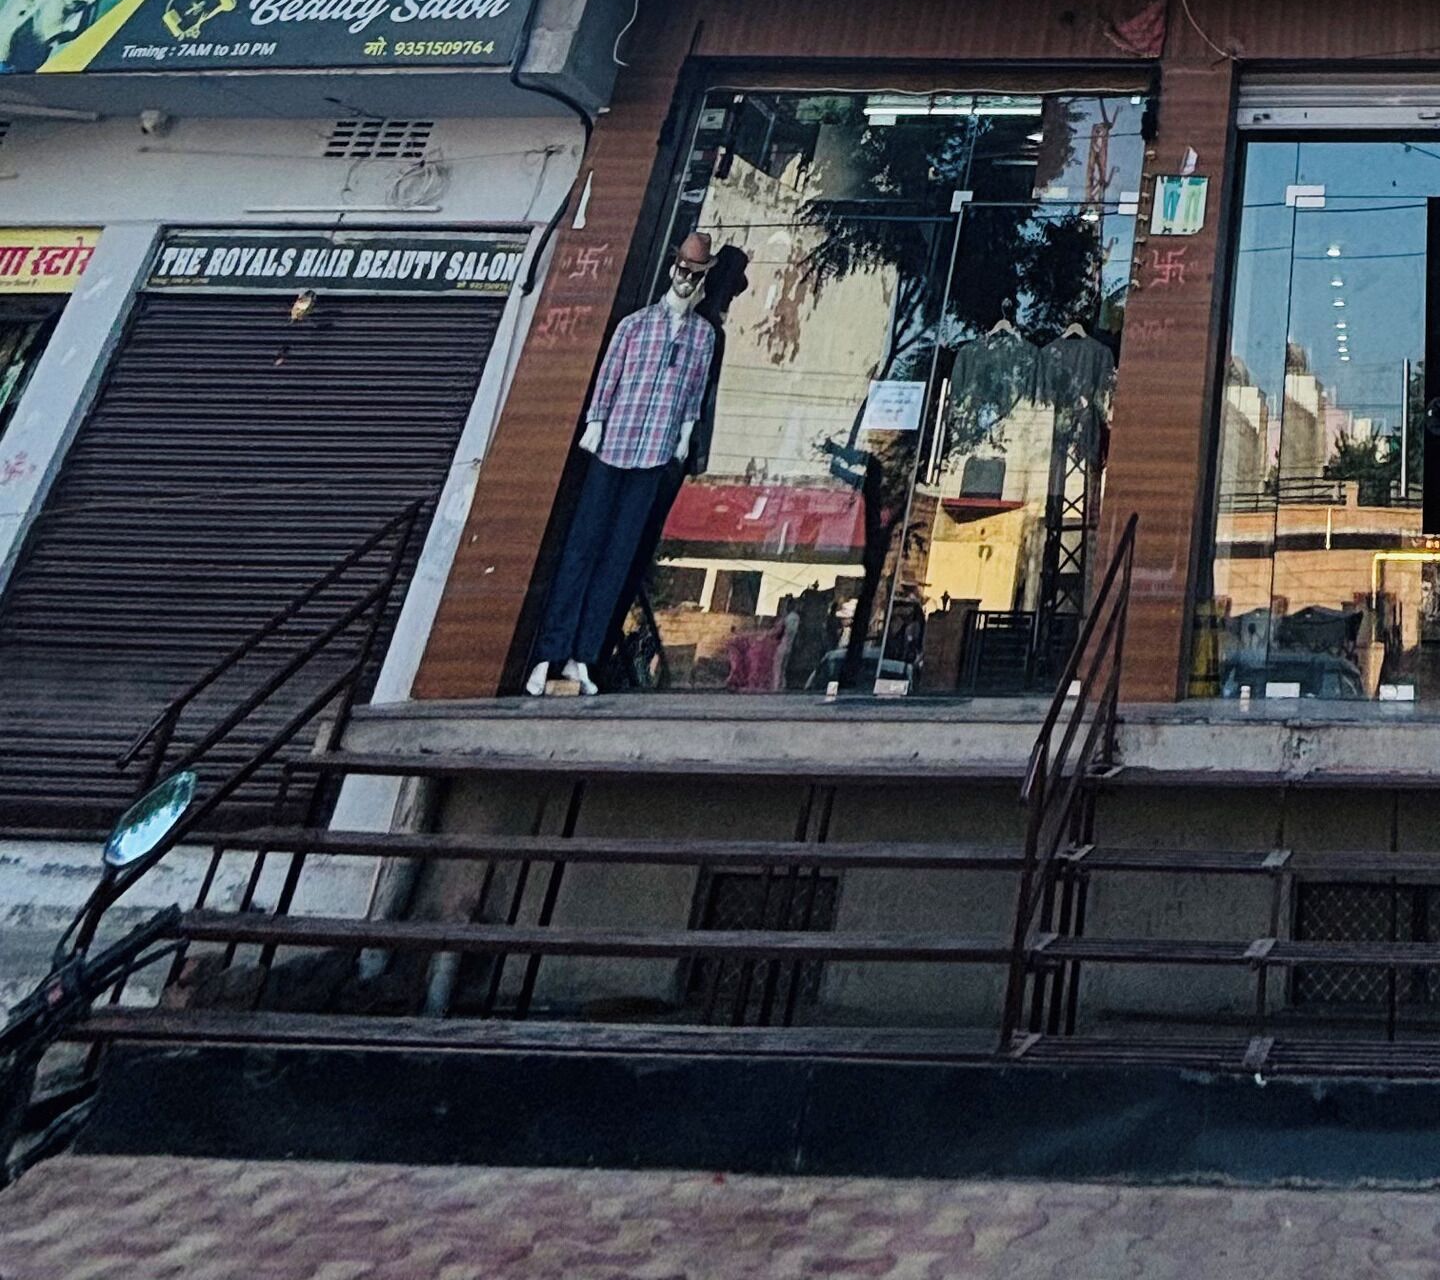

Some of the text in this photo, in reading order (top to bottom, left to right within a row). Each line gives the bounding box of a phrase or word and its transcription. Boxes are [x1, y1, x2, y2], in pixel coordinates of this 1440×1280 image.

[122, 44, 167, 60] Timing
[176, 44, 211, 58] 7AM
[213, 44, 229, 57] to
[230, 44, 250, 57] 10
[251, 43, 277, 57] PM
[394, 40, 495, 56] 9351509764
[158, 246, 524, 282] THE ROYALS HAIR BEAUTY SALON
